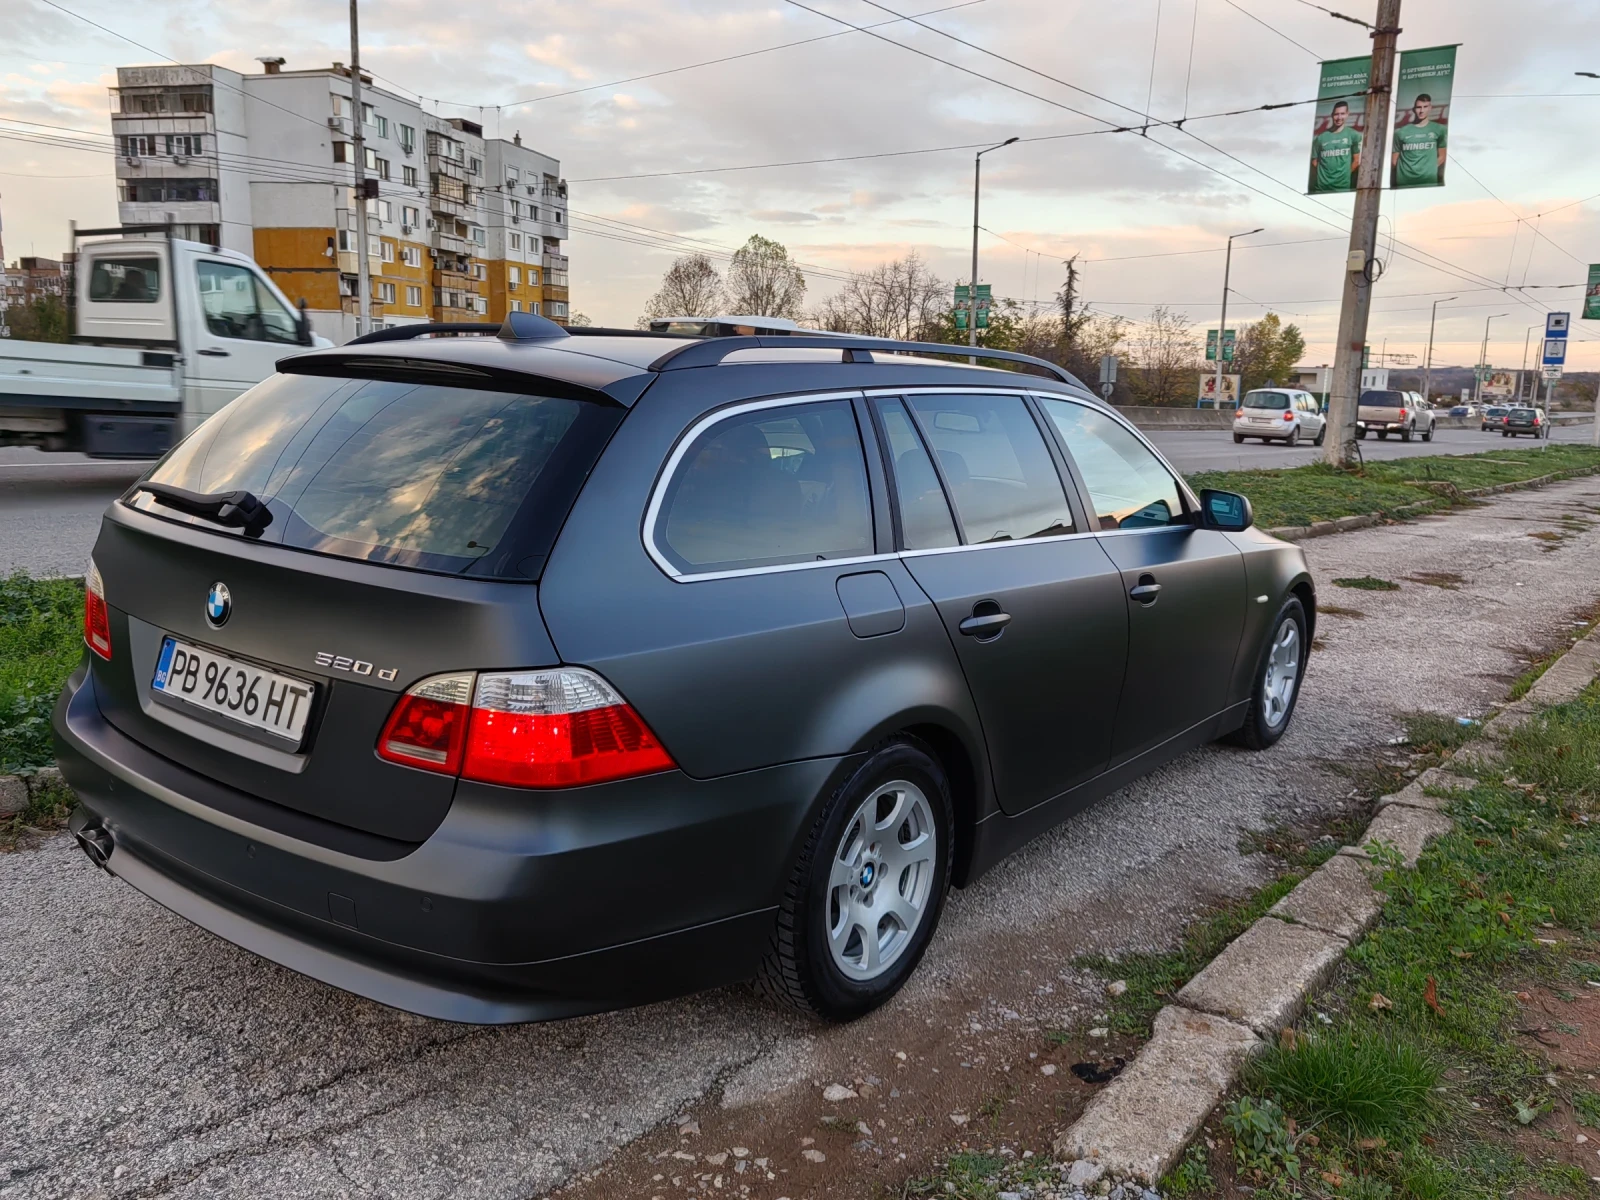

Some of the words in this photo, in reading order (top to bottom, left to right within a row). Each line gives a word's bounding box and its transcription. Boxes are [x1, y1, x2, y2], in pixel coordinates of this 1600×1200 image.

[1402, 142, 1436, 151] WINBET
[1320, 148, 1350, 158] WINBET
[156, 669, 167, 684] BG
